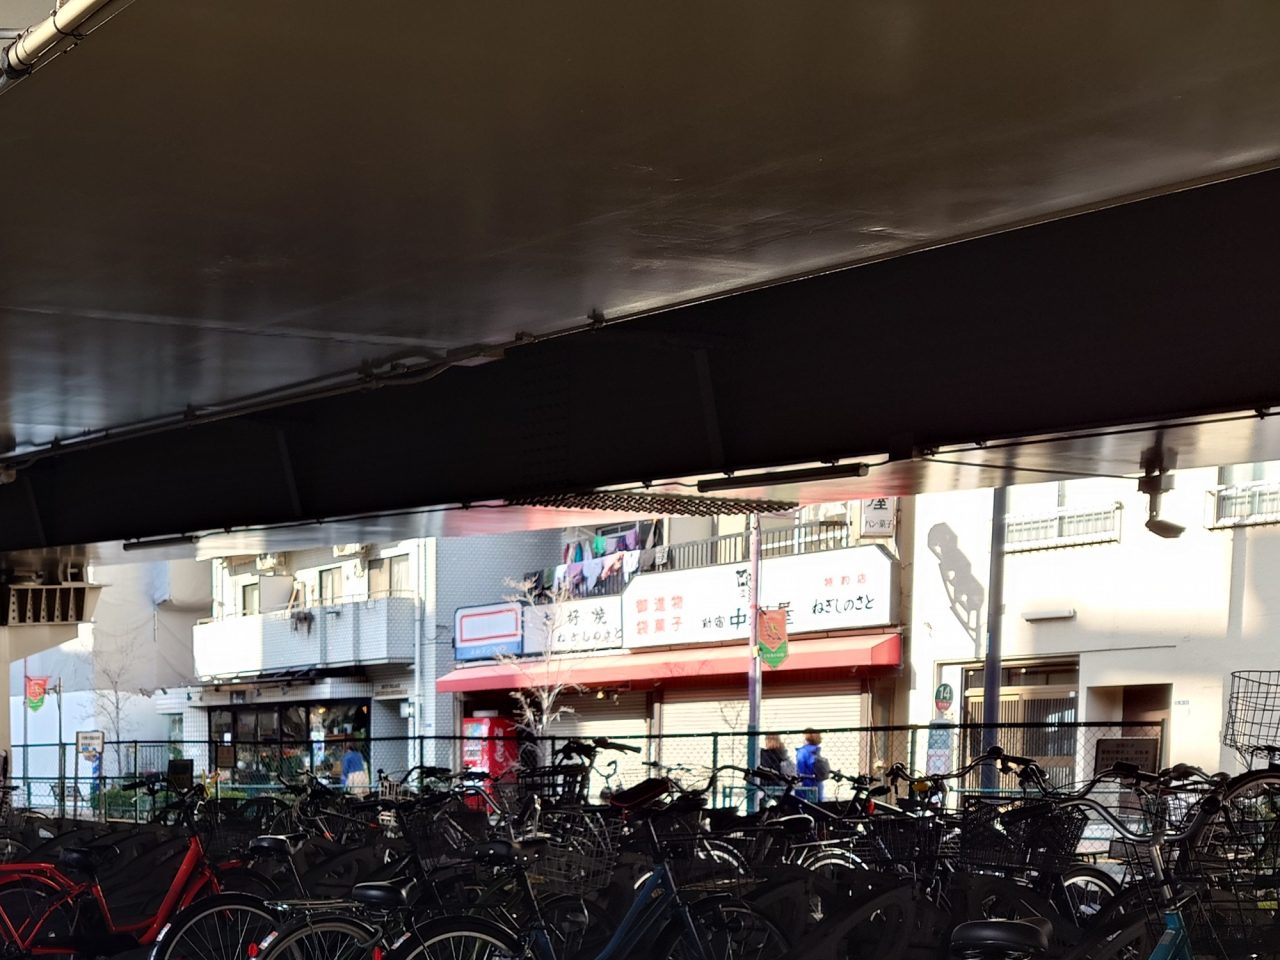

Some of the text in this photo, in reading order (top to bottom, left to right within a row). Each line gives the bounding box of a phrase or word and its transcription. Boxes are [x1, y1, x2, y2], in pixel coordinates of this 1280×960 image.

[812, 596, 876, 616] ねぎしのさと
[729, 601, 795, 632] 中屋
[939, 685, 951, 700] 14
